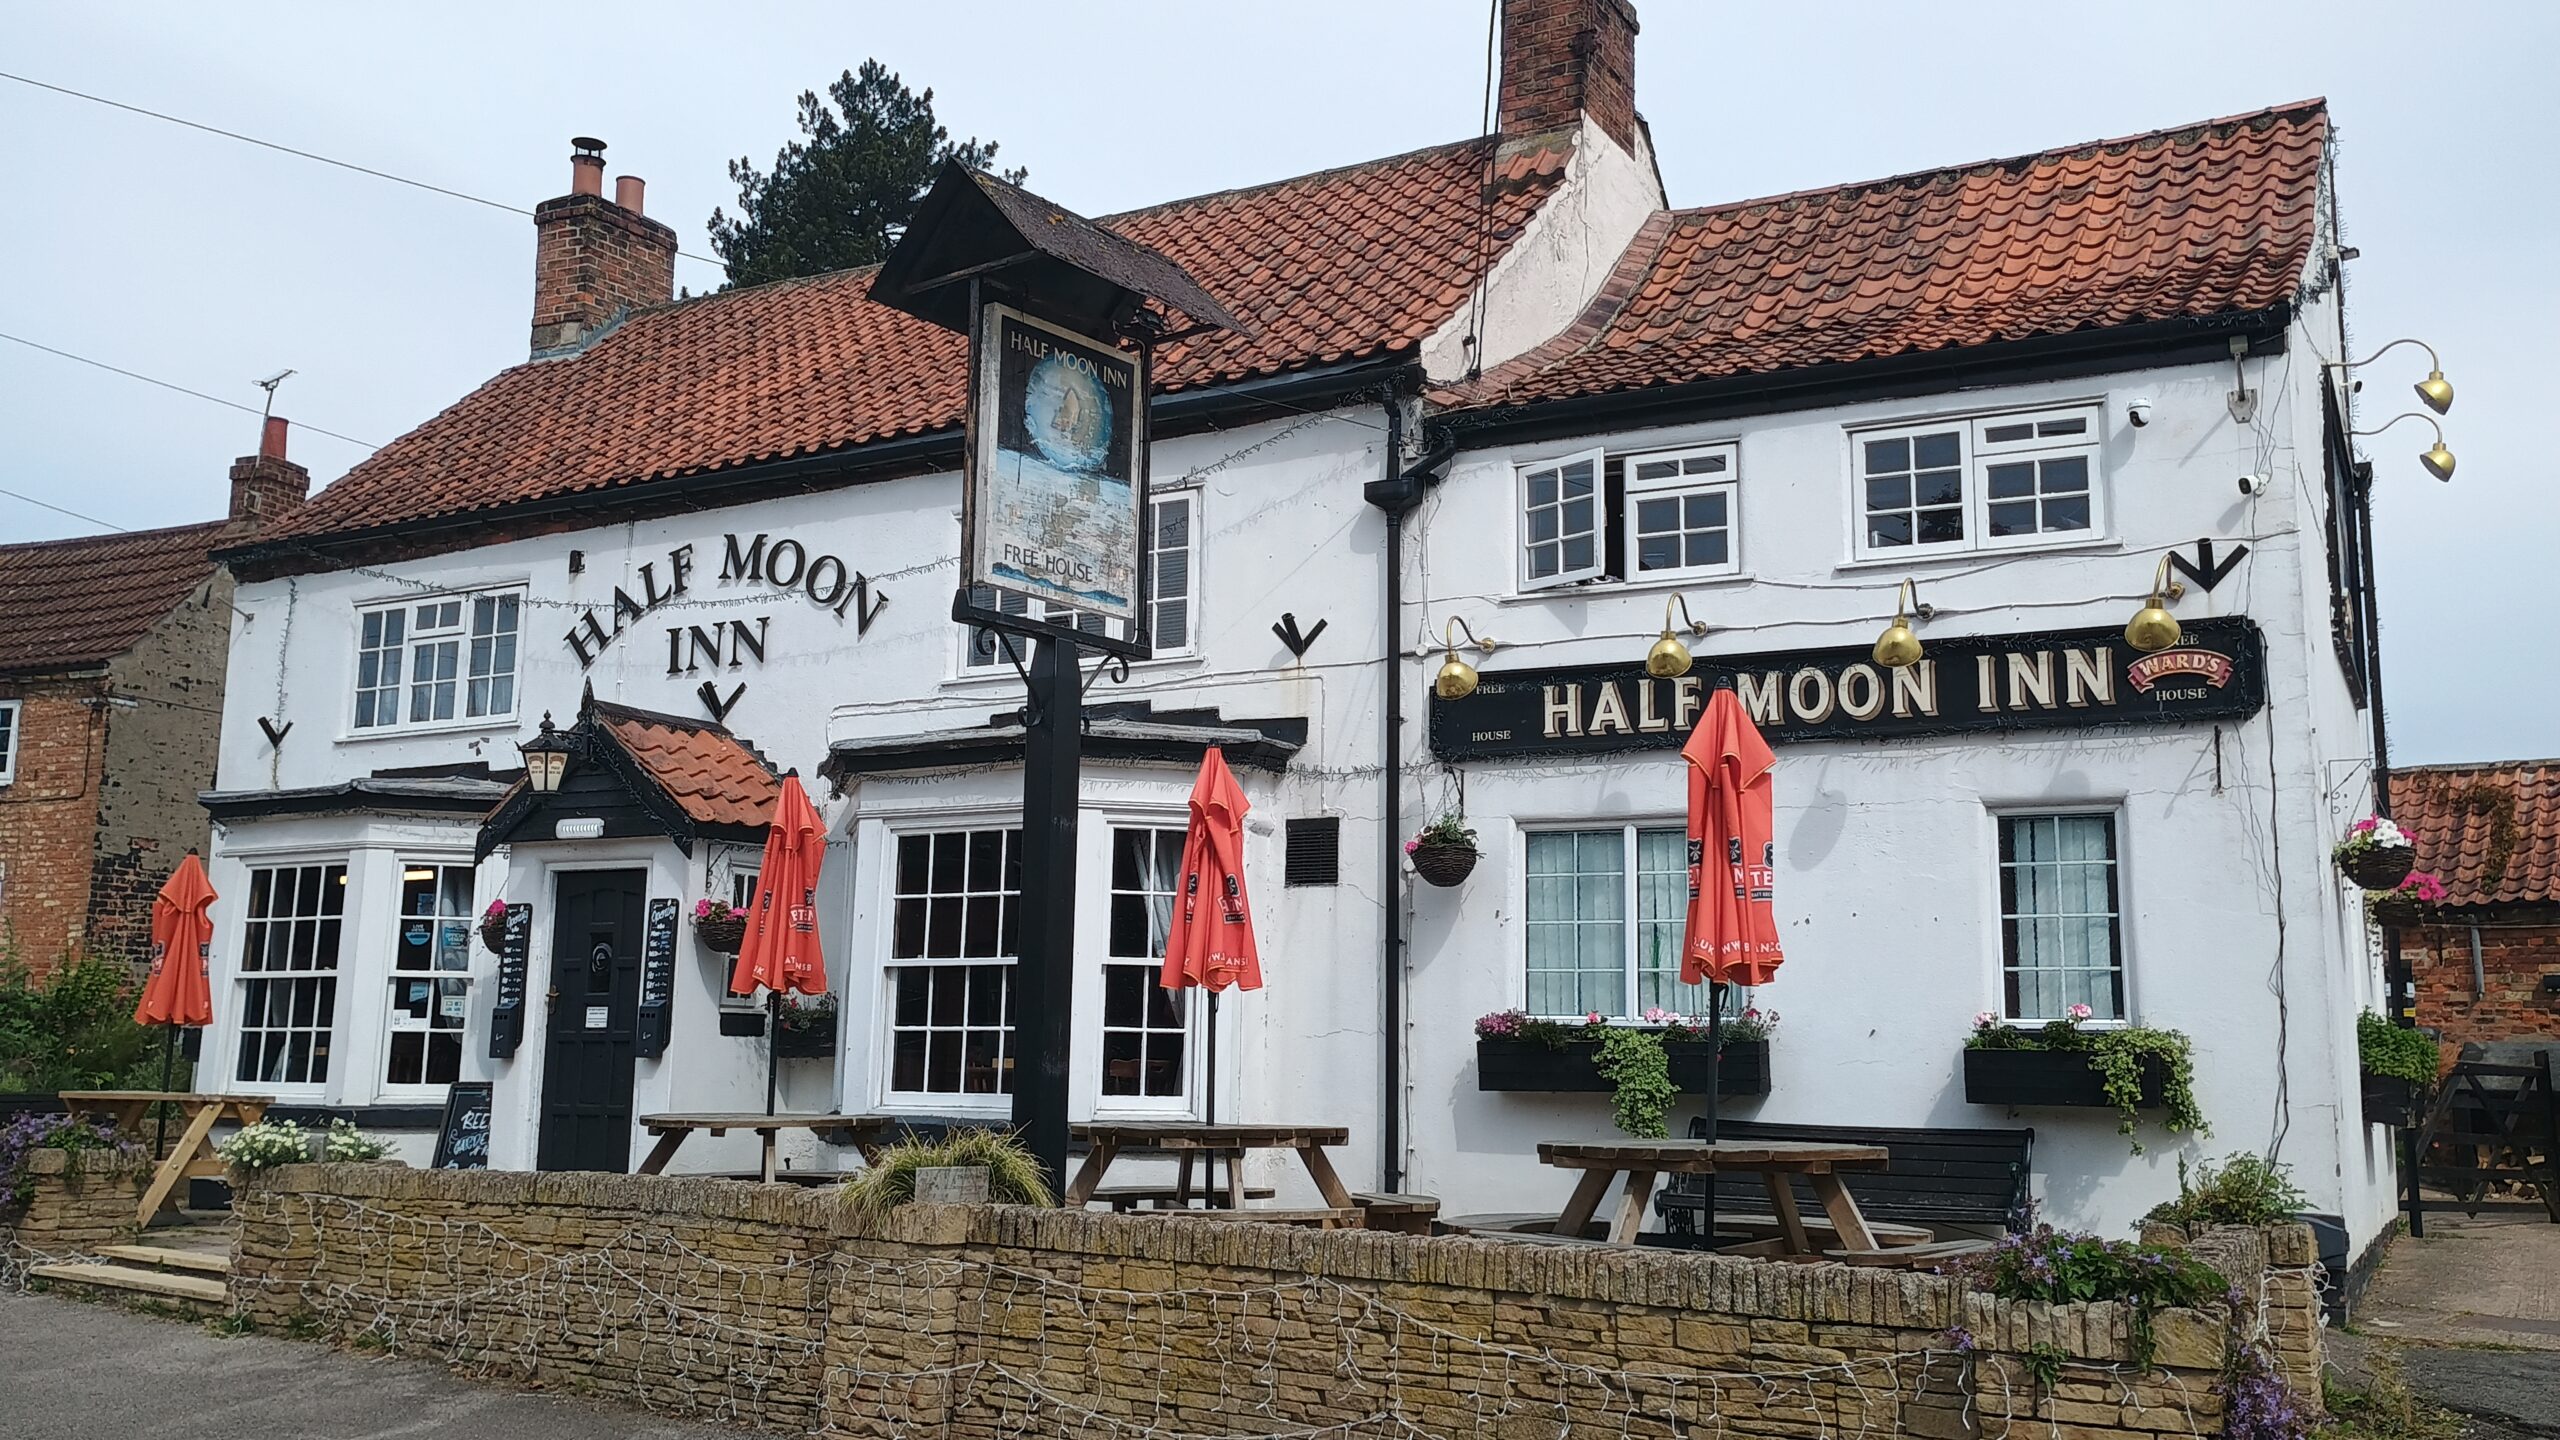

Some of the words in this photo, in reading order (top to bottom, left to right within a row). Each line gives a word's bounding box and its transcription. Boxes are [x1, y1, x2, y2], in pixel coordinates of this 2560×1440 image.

[1010, 331, 1049, 359] HALF
[1053, 347, 1098, 378] MOON
[1103, 365, 1127, 389] INN
[1004, 543, 1039, 568] FREE
[1045, 554, 1093, 582] HOUSE
[563, 543, 694, 670] HALF
[718, 533, 889, 637] MOON
[665, 616, 771, 675] INN
[2137, 653, 2221, 677] WARD'S
[1476, 683, 1506, 695] FREE
[1543, 676, 1702, 738] HALF
[1736, 660, 1939, 727] MOON
[1976, 646, 2118, 713] INN
[2155, 687, 2208, 702] HOUSE
[1472, 730, 1512, 742] HOUSE
